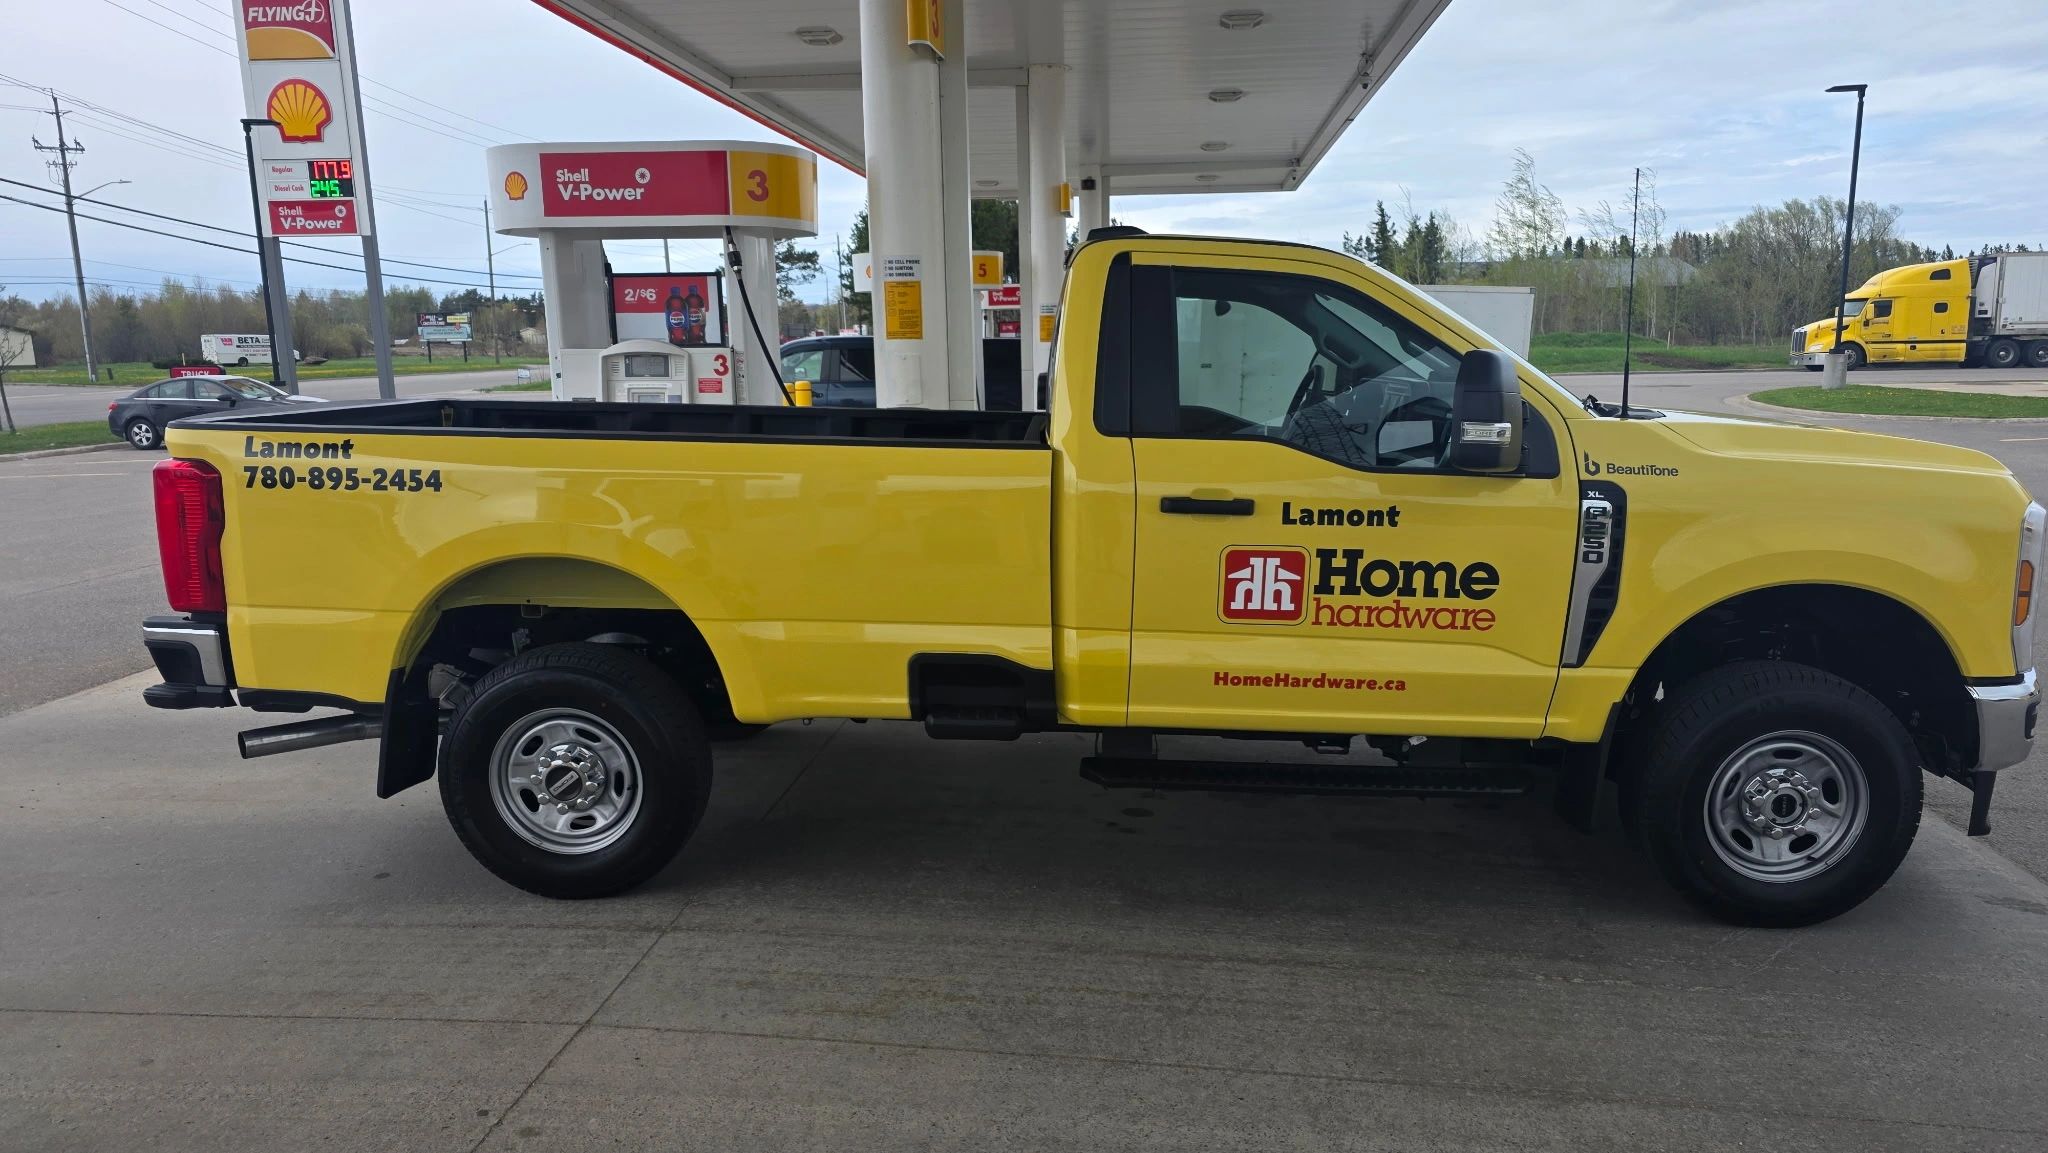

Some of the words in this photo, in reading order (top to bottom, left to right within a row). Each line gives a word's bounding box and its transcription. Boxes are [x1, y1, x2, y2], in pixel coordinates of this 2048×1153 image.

[248, 6, 304, 22] FLYING
[313, 161, 351, 179] 177.9
[556, 169, 589, 182] Shell
[558, 184, 644, 200] V-Power
[747, 170, 769, 201] 3
[278, 206, 302, 215] Shell
[280, 217, 342, 229] V-Power
[978, 264, 987, 277] 5
[713, 354, 729, 377] 3
[245, 436, 354, 459] Lamont
[244, 466, 443, 492] 780-895-2454
[1607, 463, 1679, 477] BeautiTone
[1282, 501, 1400, 528] Lamont
[1314, 548, 1500, 600] Home
[1311, 597, 1496, 631] hardware
[1213, 672, 1407, 691] HomeHardware.ca
